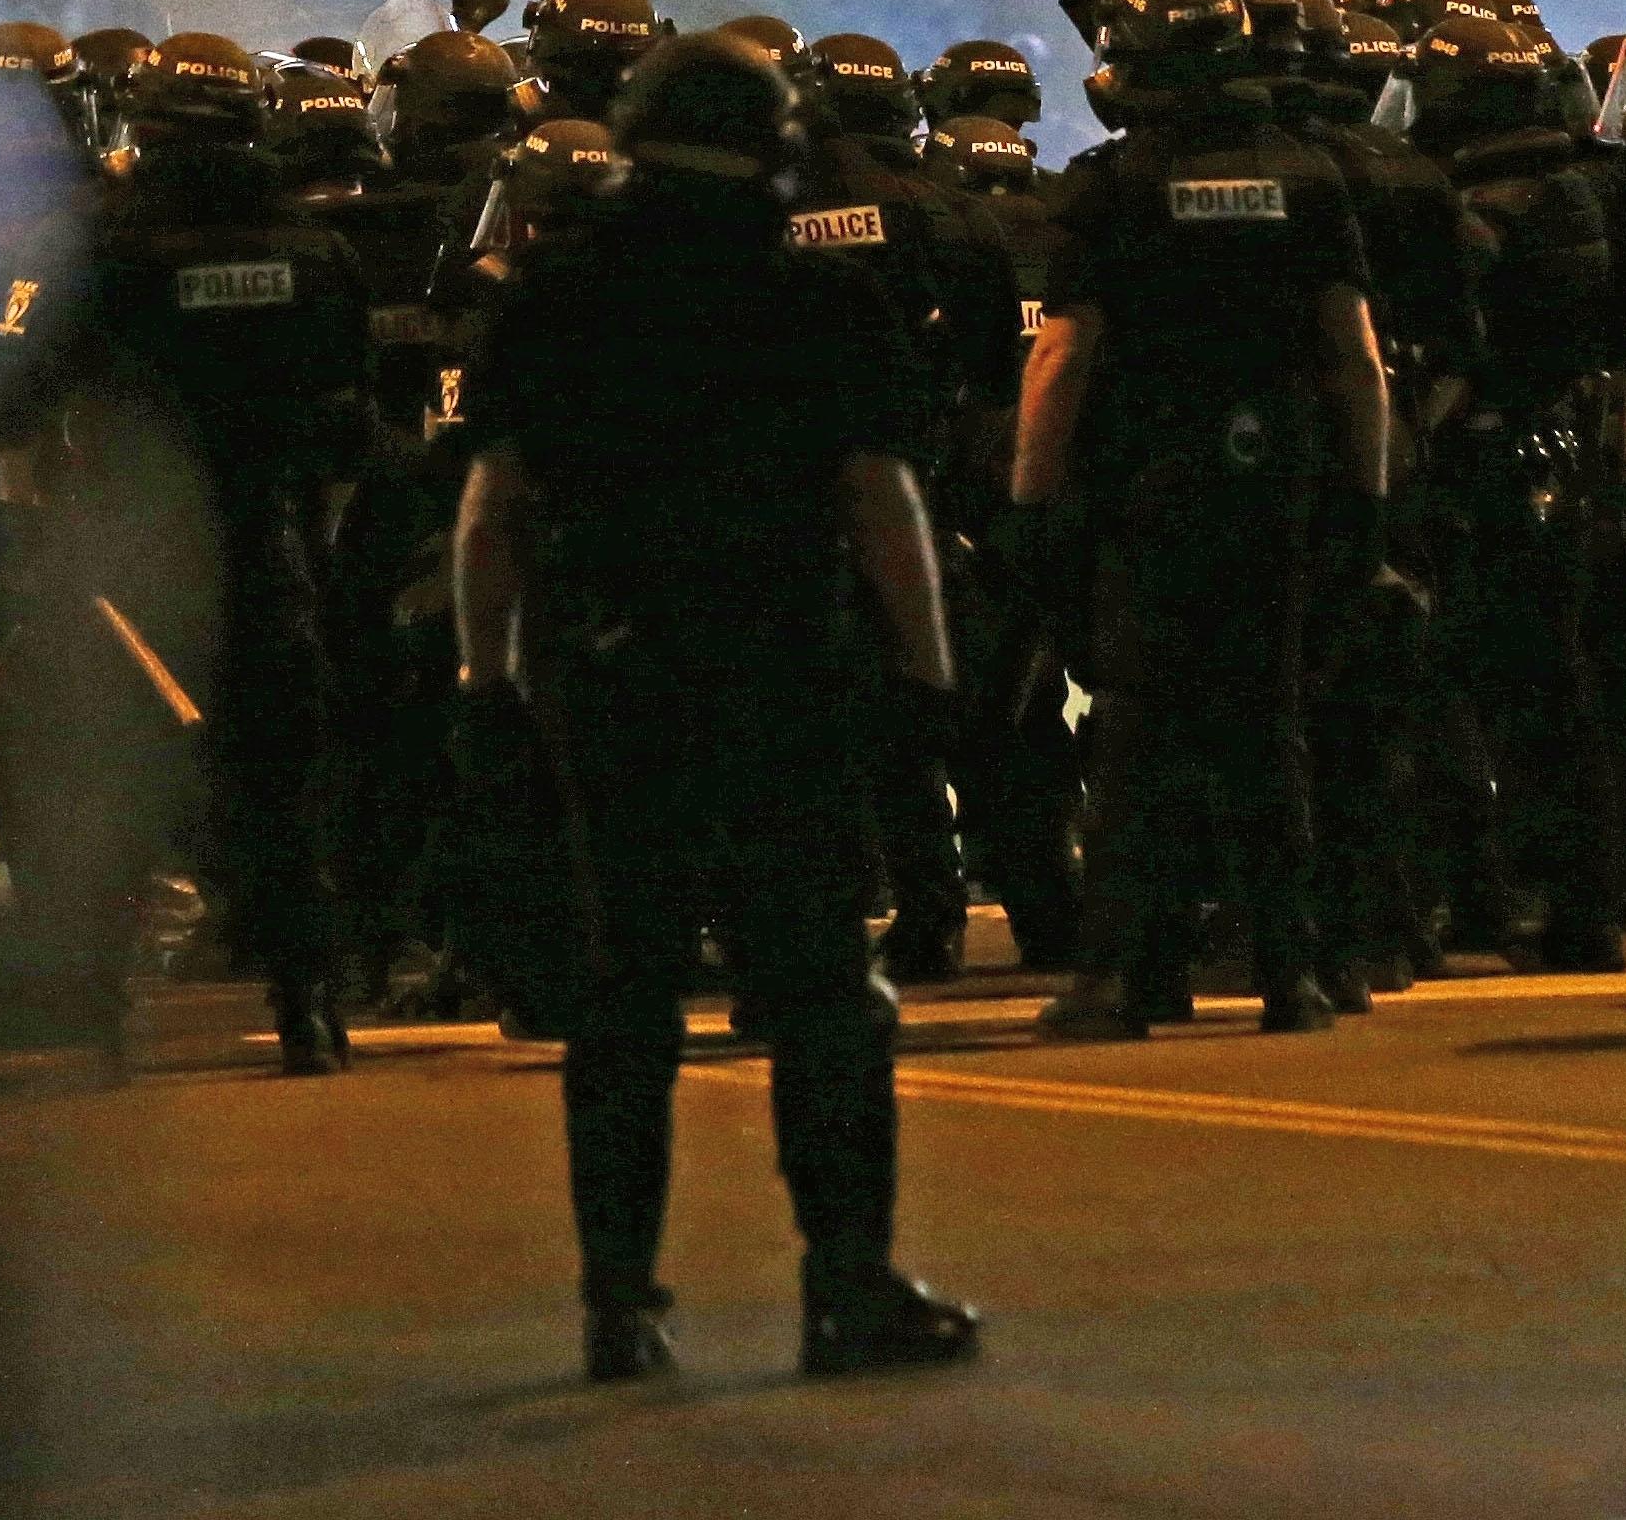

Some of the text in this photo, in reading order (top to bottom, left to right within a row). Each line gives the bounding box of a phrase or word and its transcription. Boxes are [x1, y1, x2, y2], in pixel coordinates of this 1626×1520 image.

[1446, 1, 1498, 21] POLIC
[580, 18, 649, 36] POLICE
[1350, 41, 1399, 54] OLICE
[175, 61, 249, 84] POLICE
[970, 60, 1028, 74] POLICE
[300, 96, 364, 113] POLICE
[971, 141, 1028, 157] POLICE
[1175, 184, 1277, 214] POLICE
[789, 212, 877, 244] POLICE
[183, 269, 289, 303] POLICE
